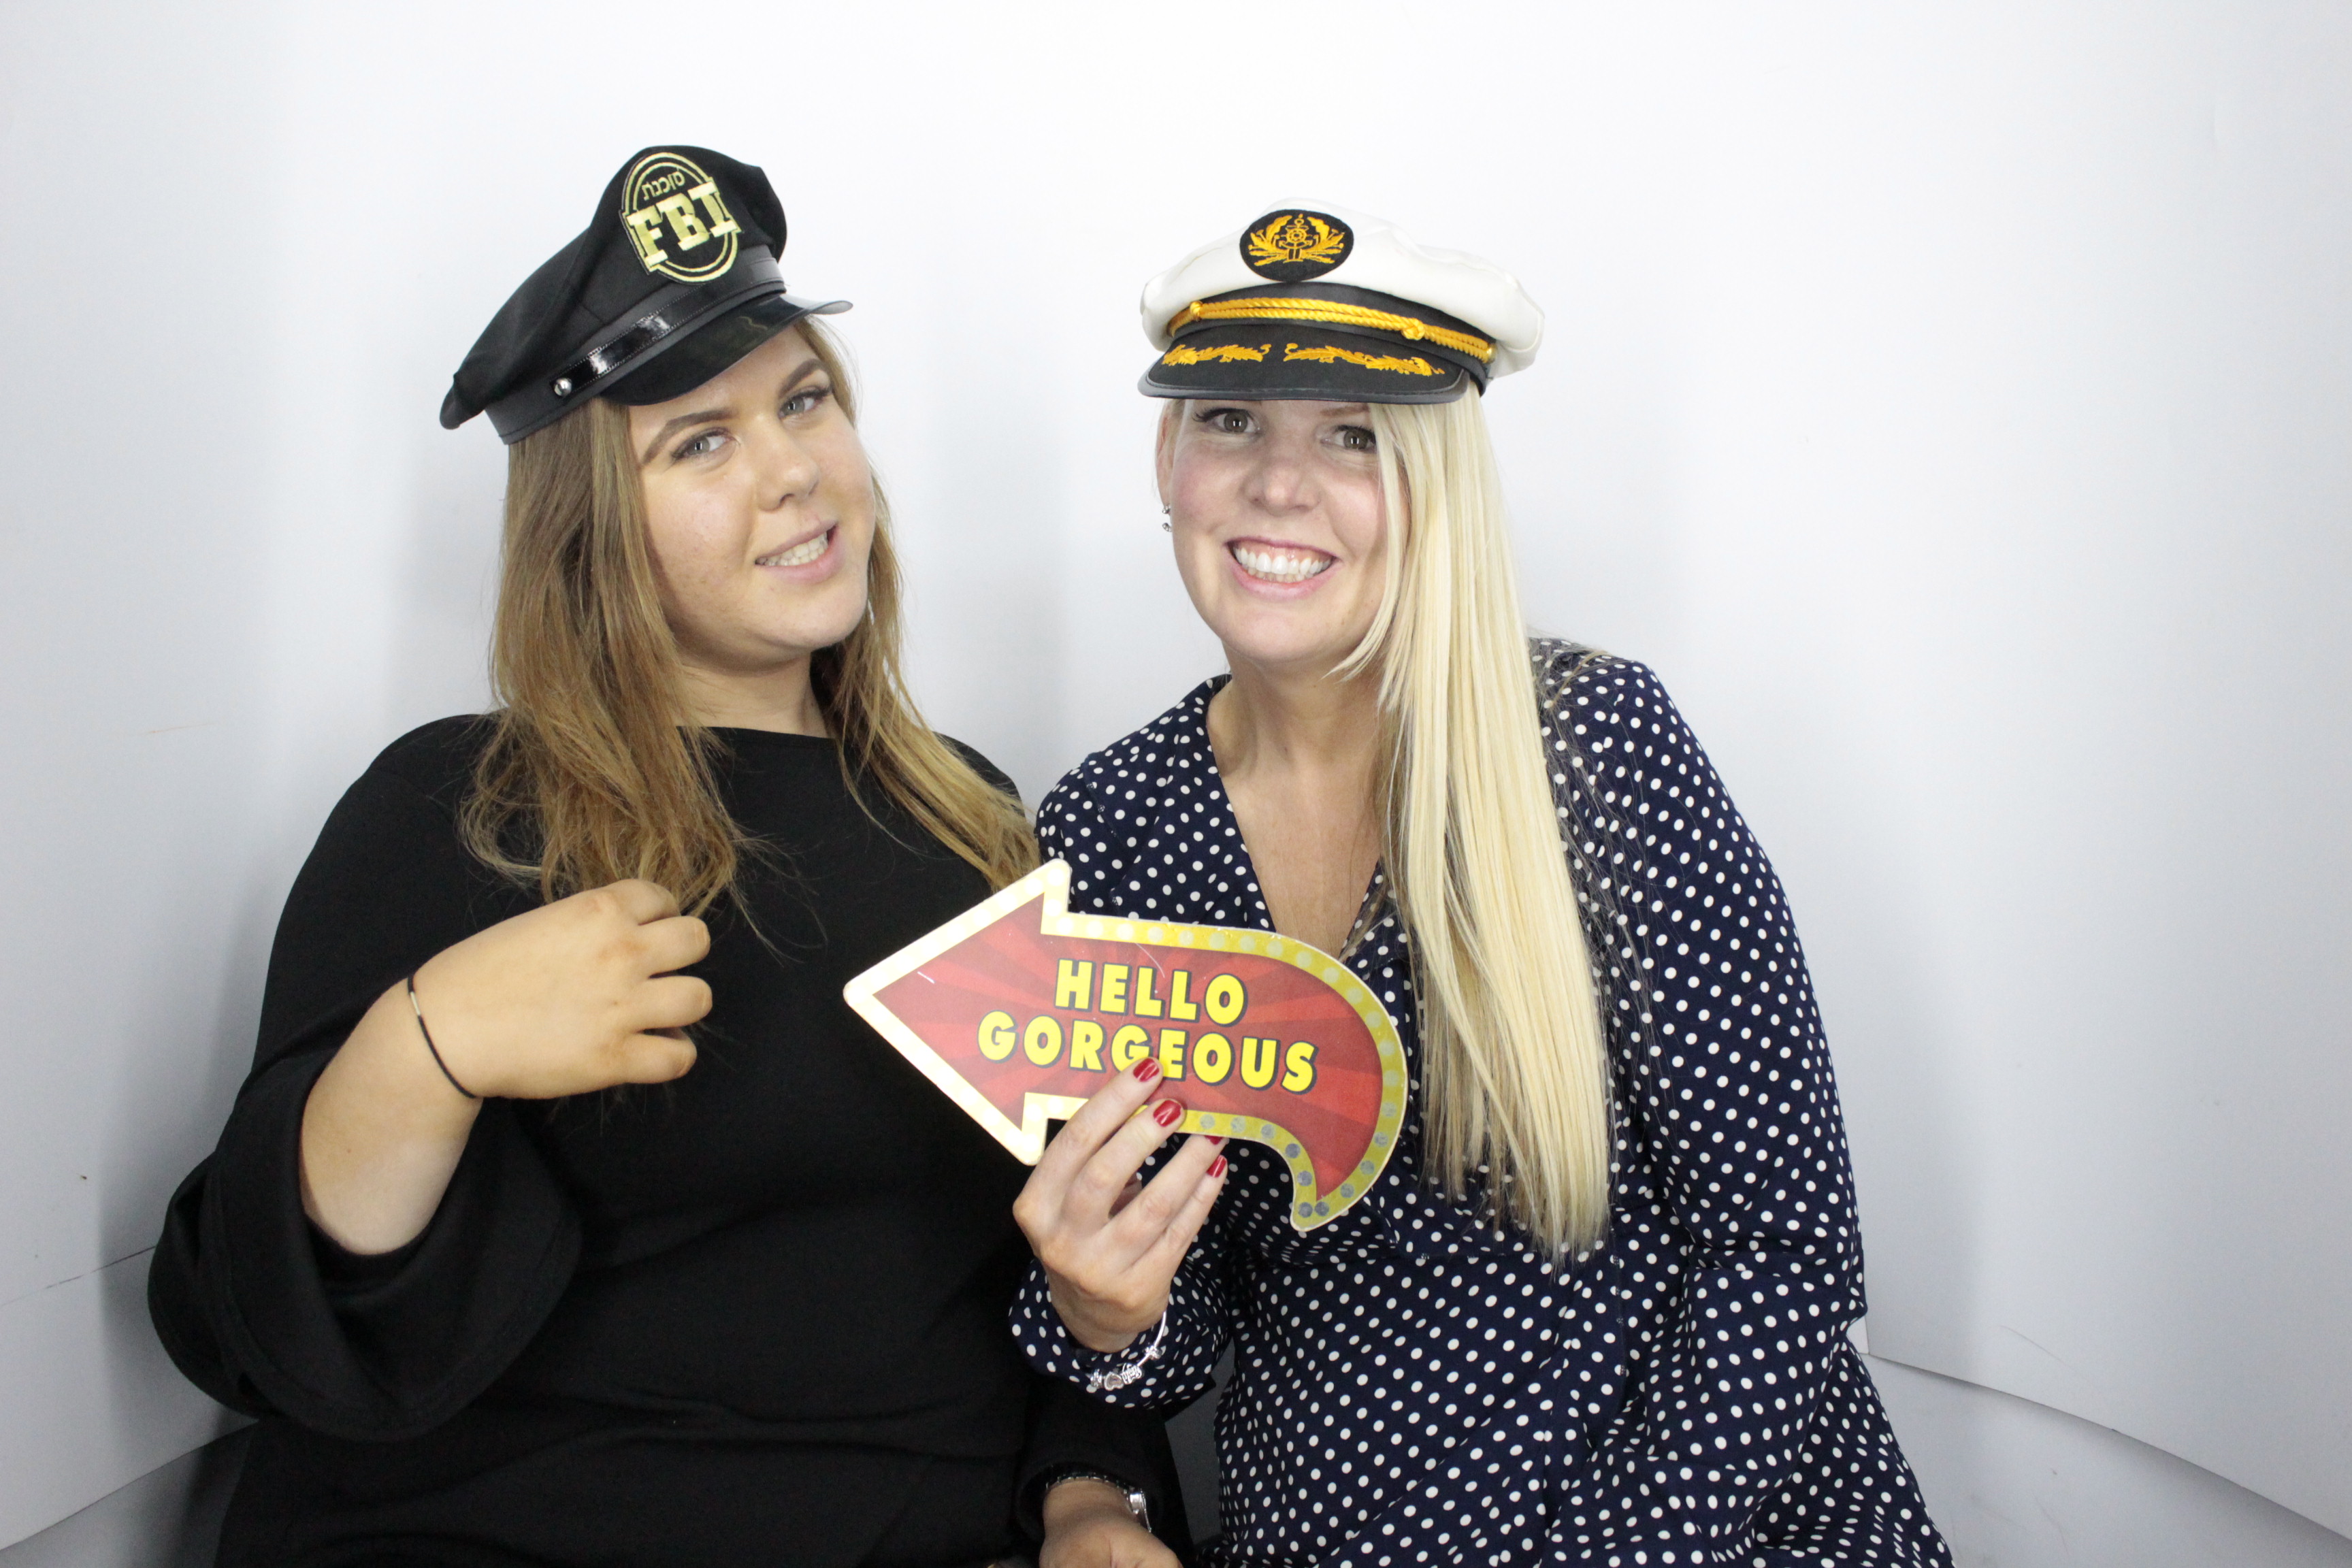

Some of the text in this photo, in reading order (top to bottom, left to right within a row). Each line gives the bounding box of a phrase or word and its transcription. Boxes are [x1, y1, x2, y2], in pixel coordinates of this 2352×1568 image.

[625, 181, 738, 265] FBI
[642, 172, 685, 201] סוכנת
[1055, 958, 1247, 1027] HELLO
[977, 1010, 1319, 1094] GORGEOUS
